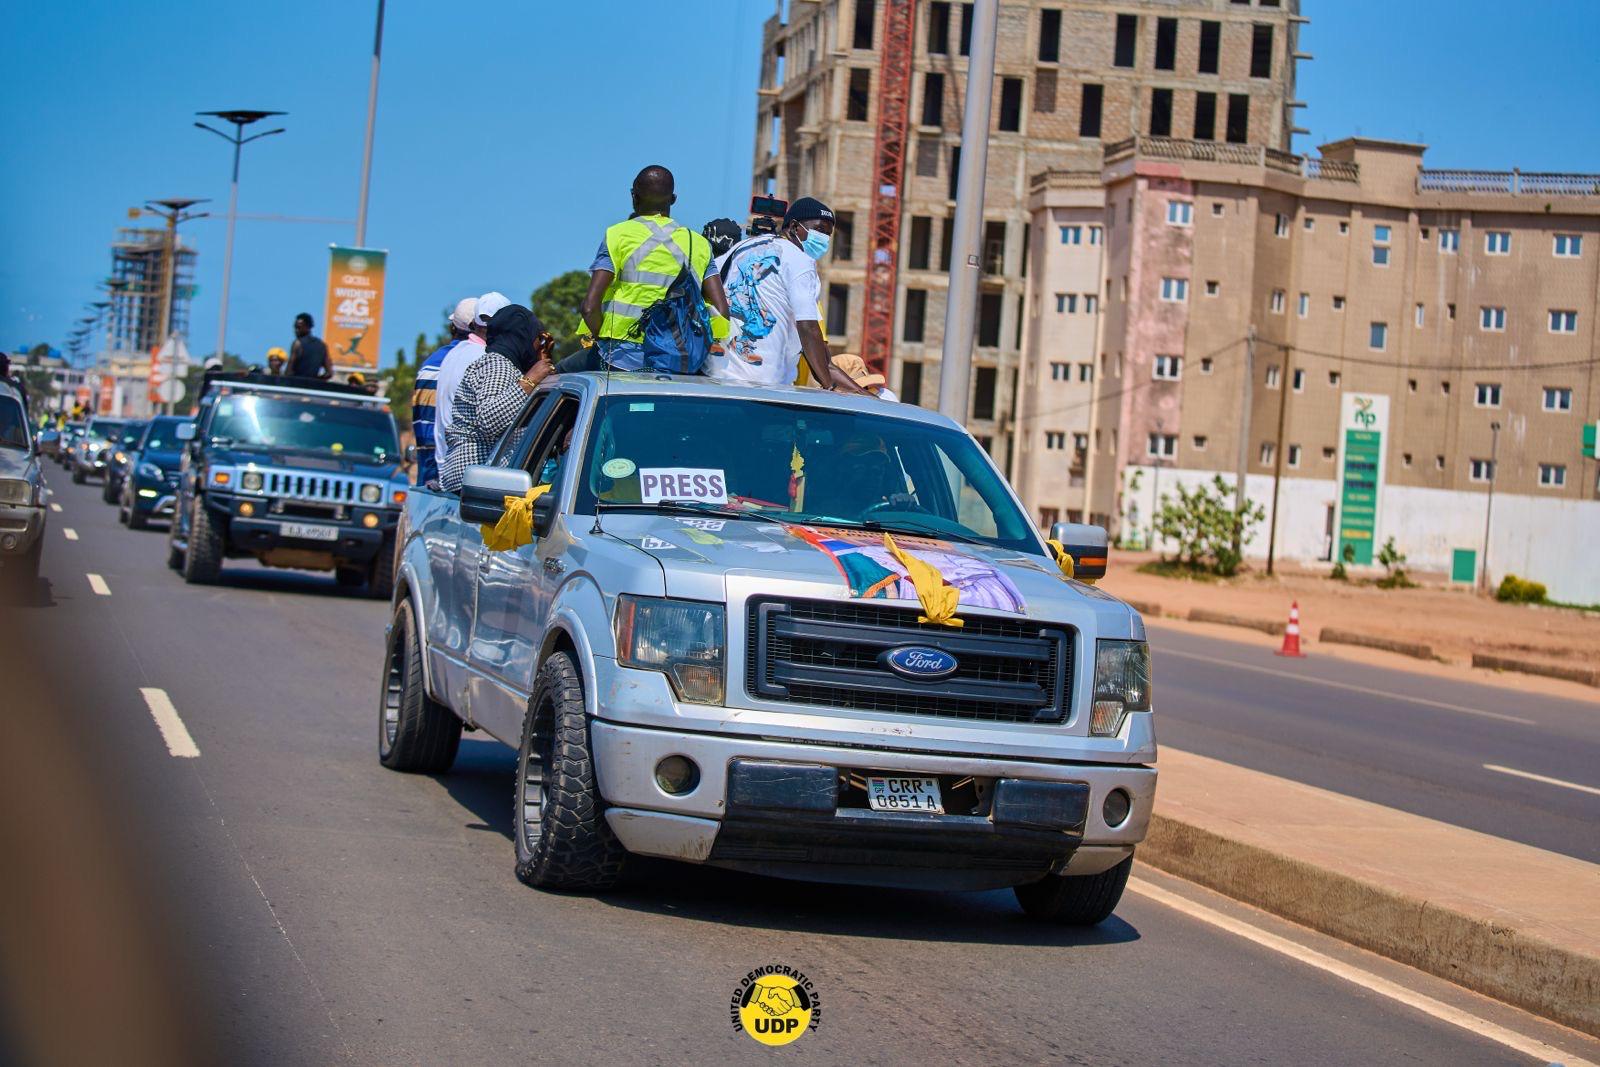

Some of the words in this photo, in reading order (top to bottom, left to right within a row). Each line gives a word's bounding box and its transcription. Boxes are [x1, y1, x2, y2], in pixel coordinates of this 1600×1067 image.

[336, 299, 369, 317] 4G
[643, 474, 724, 498] PRESS
[905, 651, 942, 669] Ford
[888, 779, 924, 793] CRR
[876, 795, 921, 808] 0851
[927, 795, 936, 809] A
